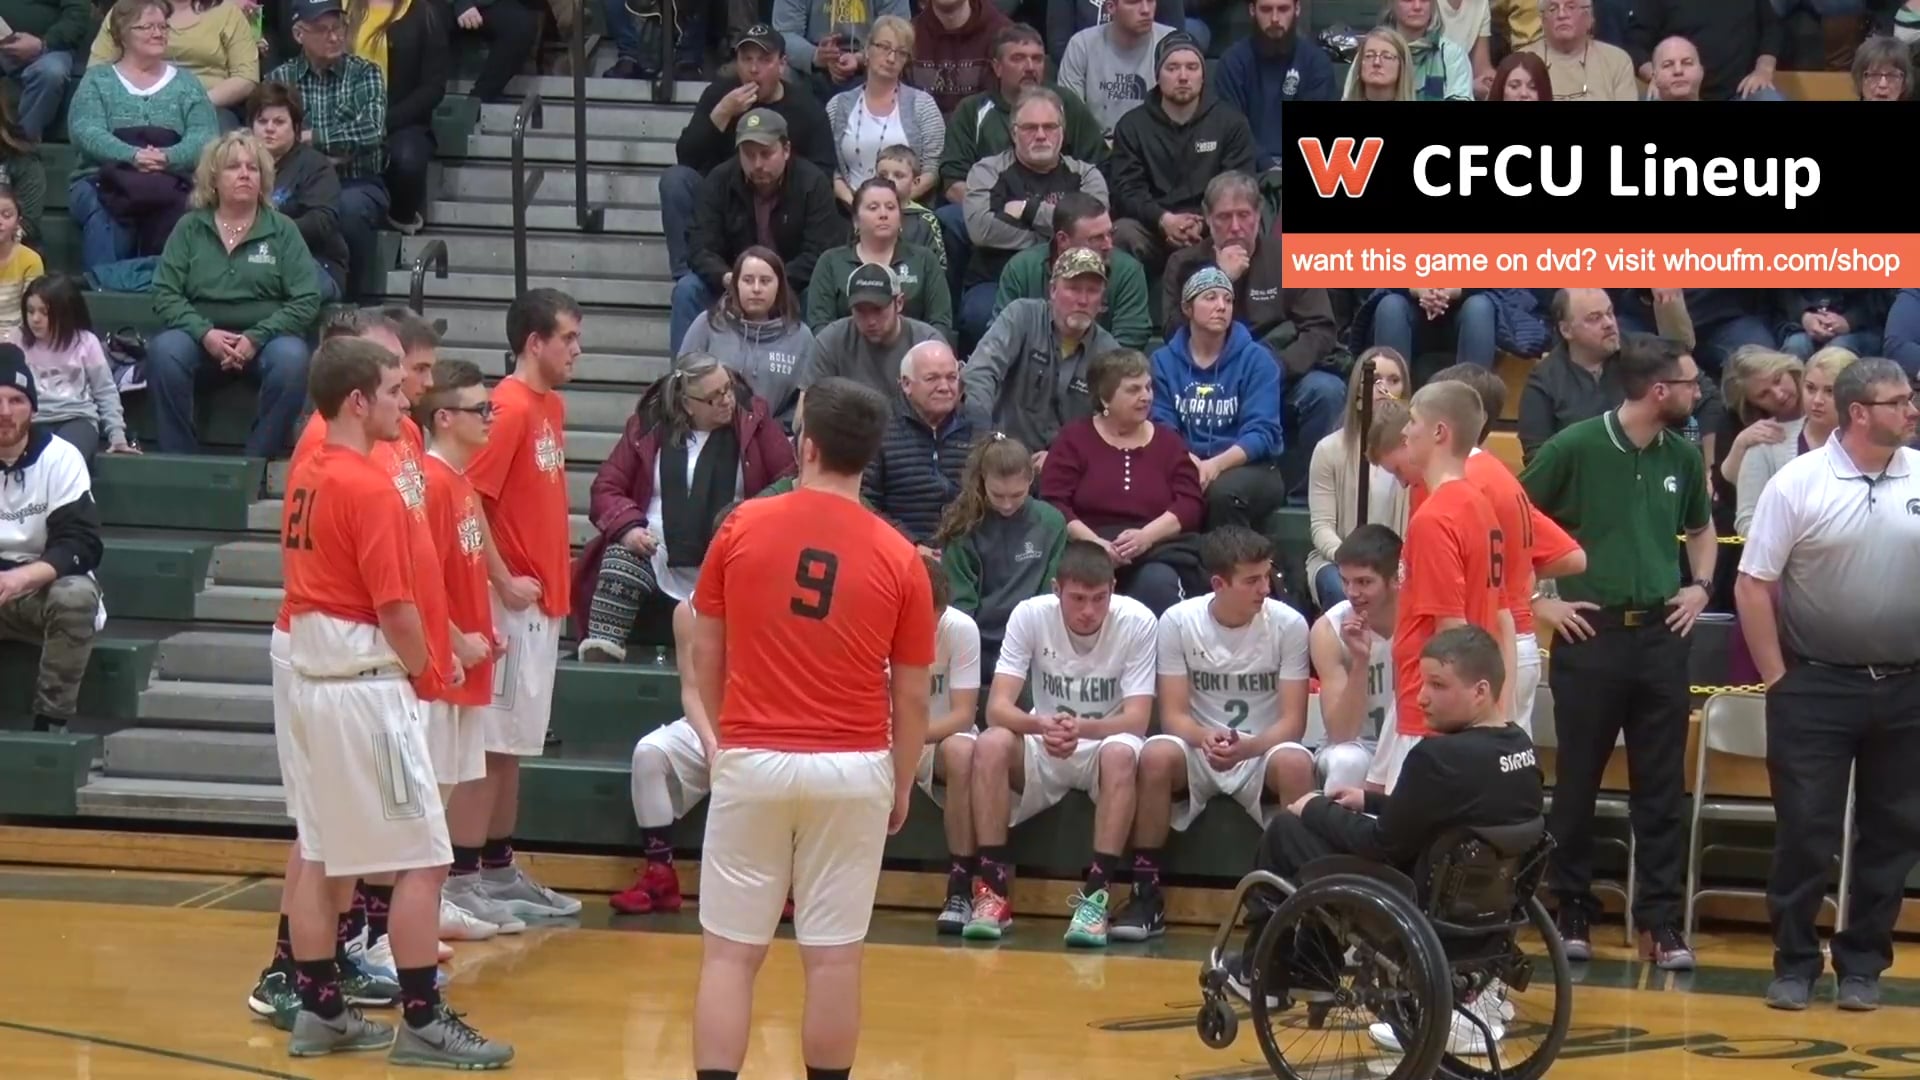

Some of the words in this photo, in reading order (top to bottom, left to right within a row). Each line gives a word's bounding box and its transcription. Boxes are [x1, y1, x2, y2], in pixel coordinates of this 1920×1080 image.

[1115, 73, 1134, 83] THE
[286, 487, 316, 551] 21
[790, 547, 839, 621] 9
[1042, 672, 1075, 701] FORT
[1079, 676, 1118, 703] KENT
[1192, 671, 1230, 693] FORT
[1237, 671, 1279, 693] KENT
[1223, 699, 1252, 734] 2
